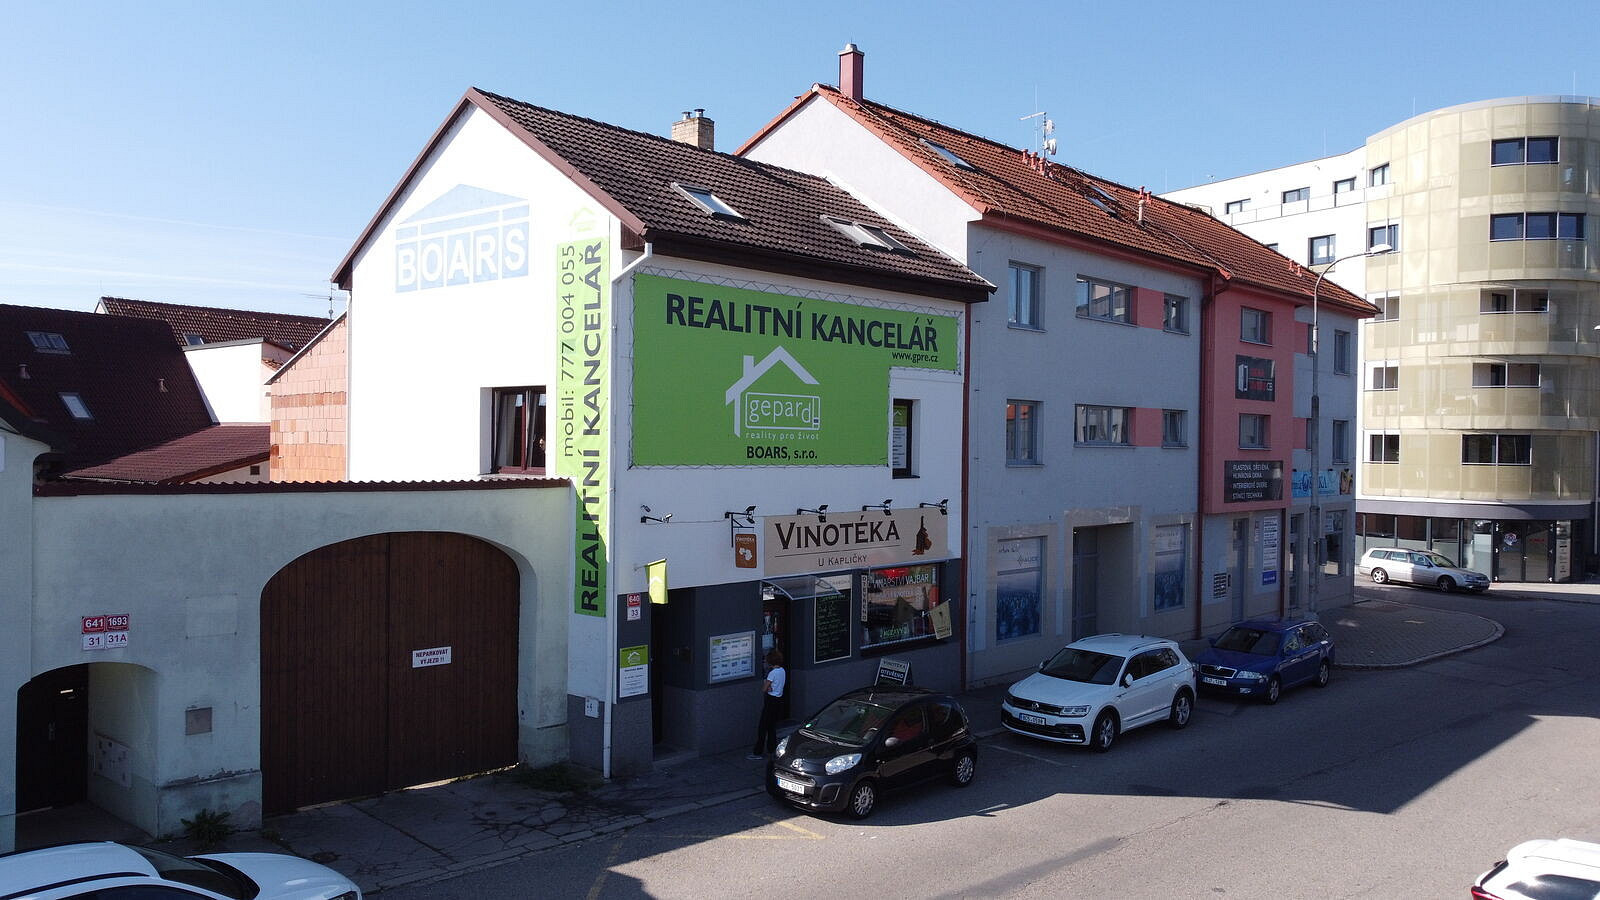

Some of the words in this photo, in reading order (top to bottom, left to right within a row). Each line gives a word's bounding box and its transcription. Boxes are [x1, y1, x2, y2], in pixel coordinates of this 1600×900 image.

[397, 228, 527, 287] BOARS
[561, 245, 575, 285] 055
[561, 293, 575, 334] 004
[666, 293, 802, 339] REALITNÍ
[811, 317, 938, 352] KANCELÁŘ
[579, 241, 601, 436] KANCELÁŘ
[561, 341, 575, 381] 777
[892, 351, 938, 364] www.gpre.cz
[561, 390, 575, 457] mobil:
[746, 431, 776, 440] reality
[780, 432, 795, 440] pro
[798, 431, 819, 440] život
[746, 446, 791, 460] BOARS,
[793, 449, 818, 459] s.r.o.
[578, 449, 600, 611] REALITNÍ
[775, 515, 901, 550] VINOTÉKA
[818, 557, 825, 567] U
[828, 553, 868, 566] KAPLIČKY
[904, 573, 929, 585] VAJBAR
[86, 619, 103, 627] 641
[108, 616, 127, 626] 1693
[89, 637, 100, 646] 31
[108, 634, 126, 643] 31A
